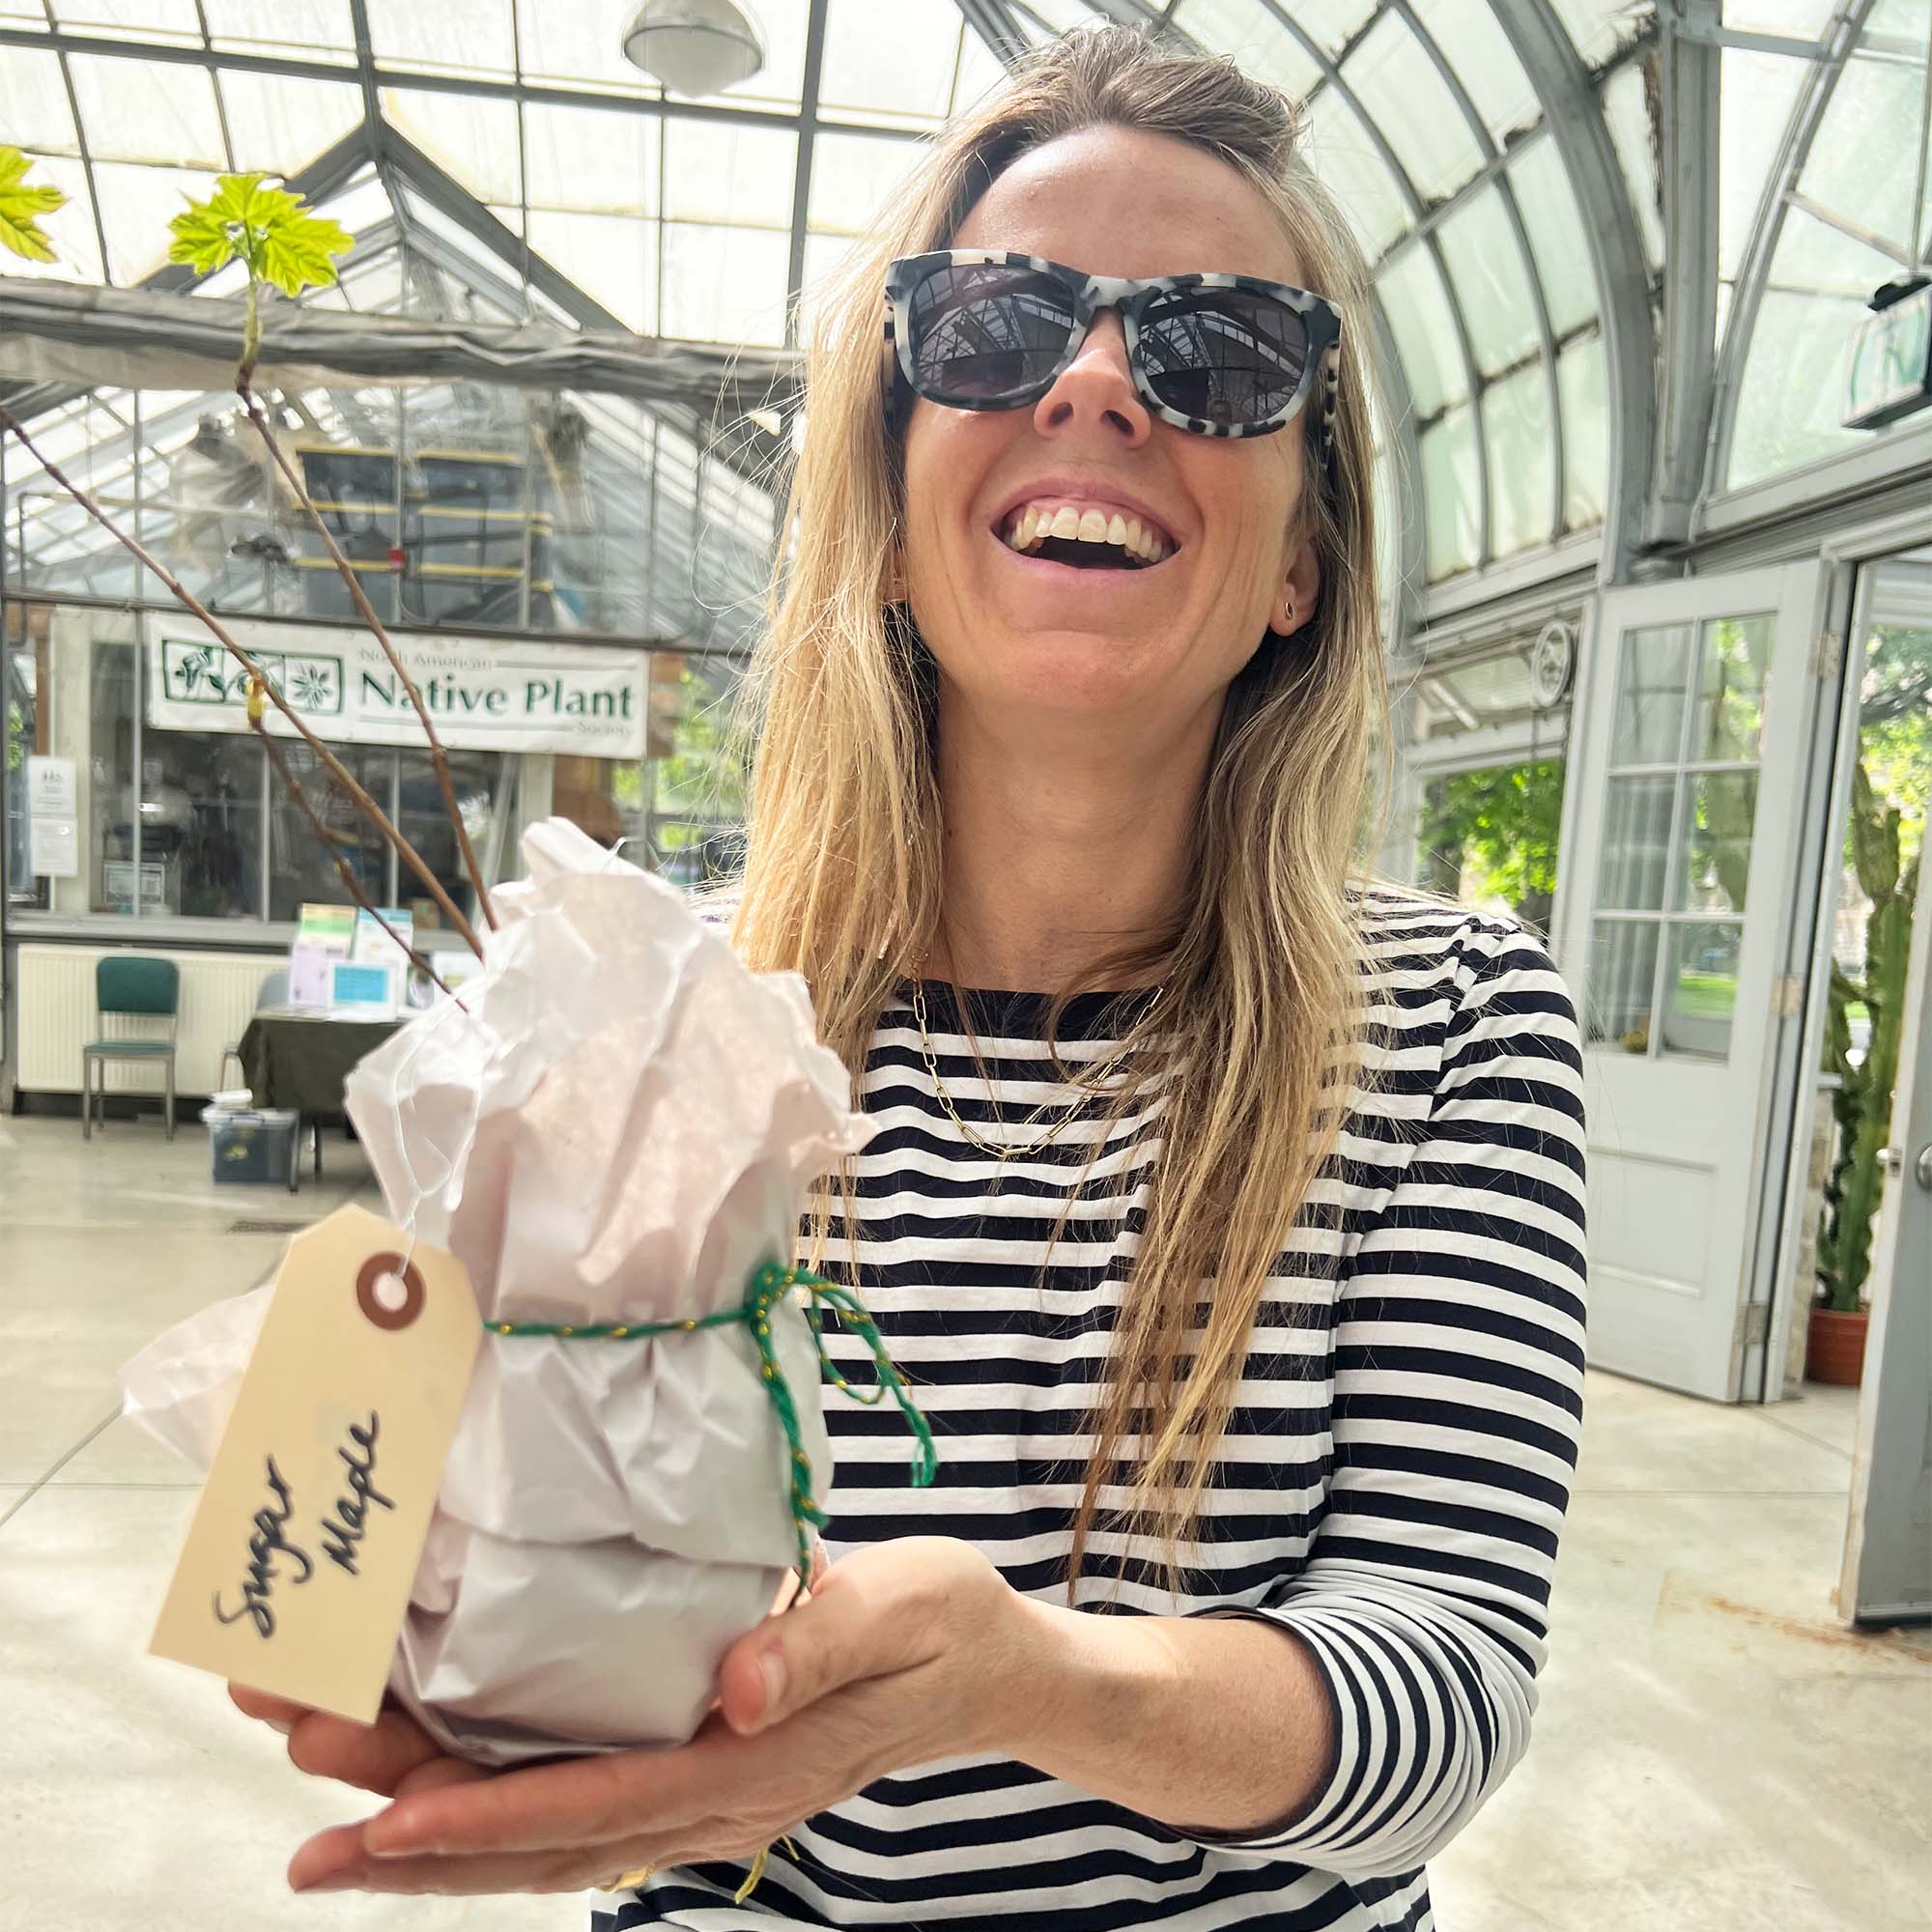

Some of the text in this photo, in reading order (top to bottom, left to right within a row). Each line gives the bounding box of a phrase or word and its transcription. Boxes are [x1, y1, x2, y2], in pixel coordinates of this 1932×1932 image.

[359, 647, 492, 670] Noh American
[526, 678, 632, 719] Plant
[578, 722, 633, 738] Society
[321, 1409, 396, 1577] Maple
[213, 1453, 315, 1639] Sugar
